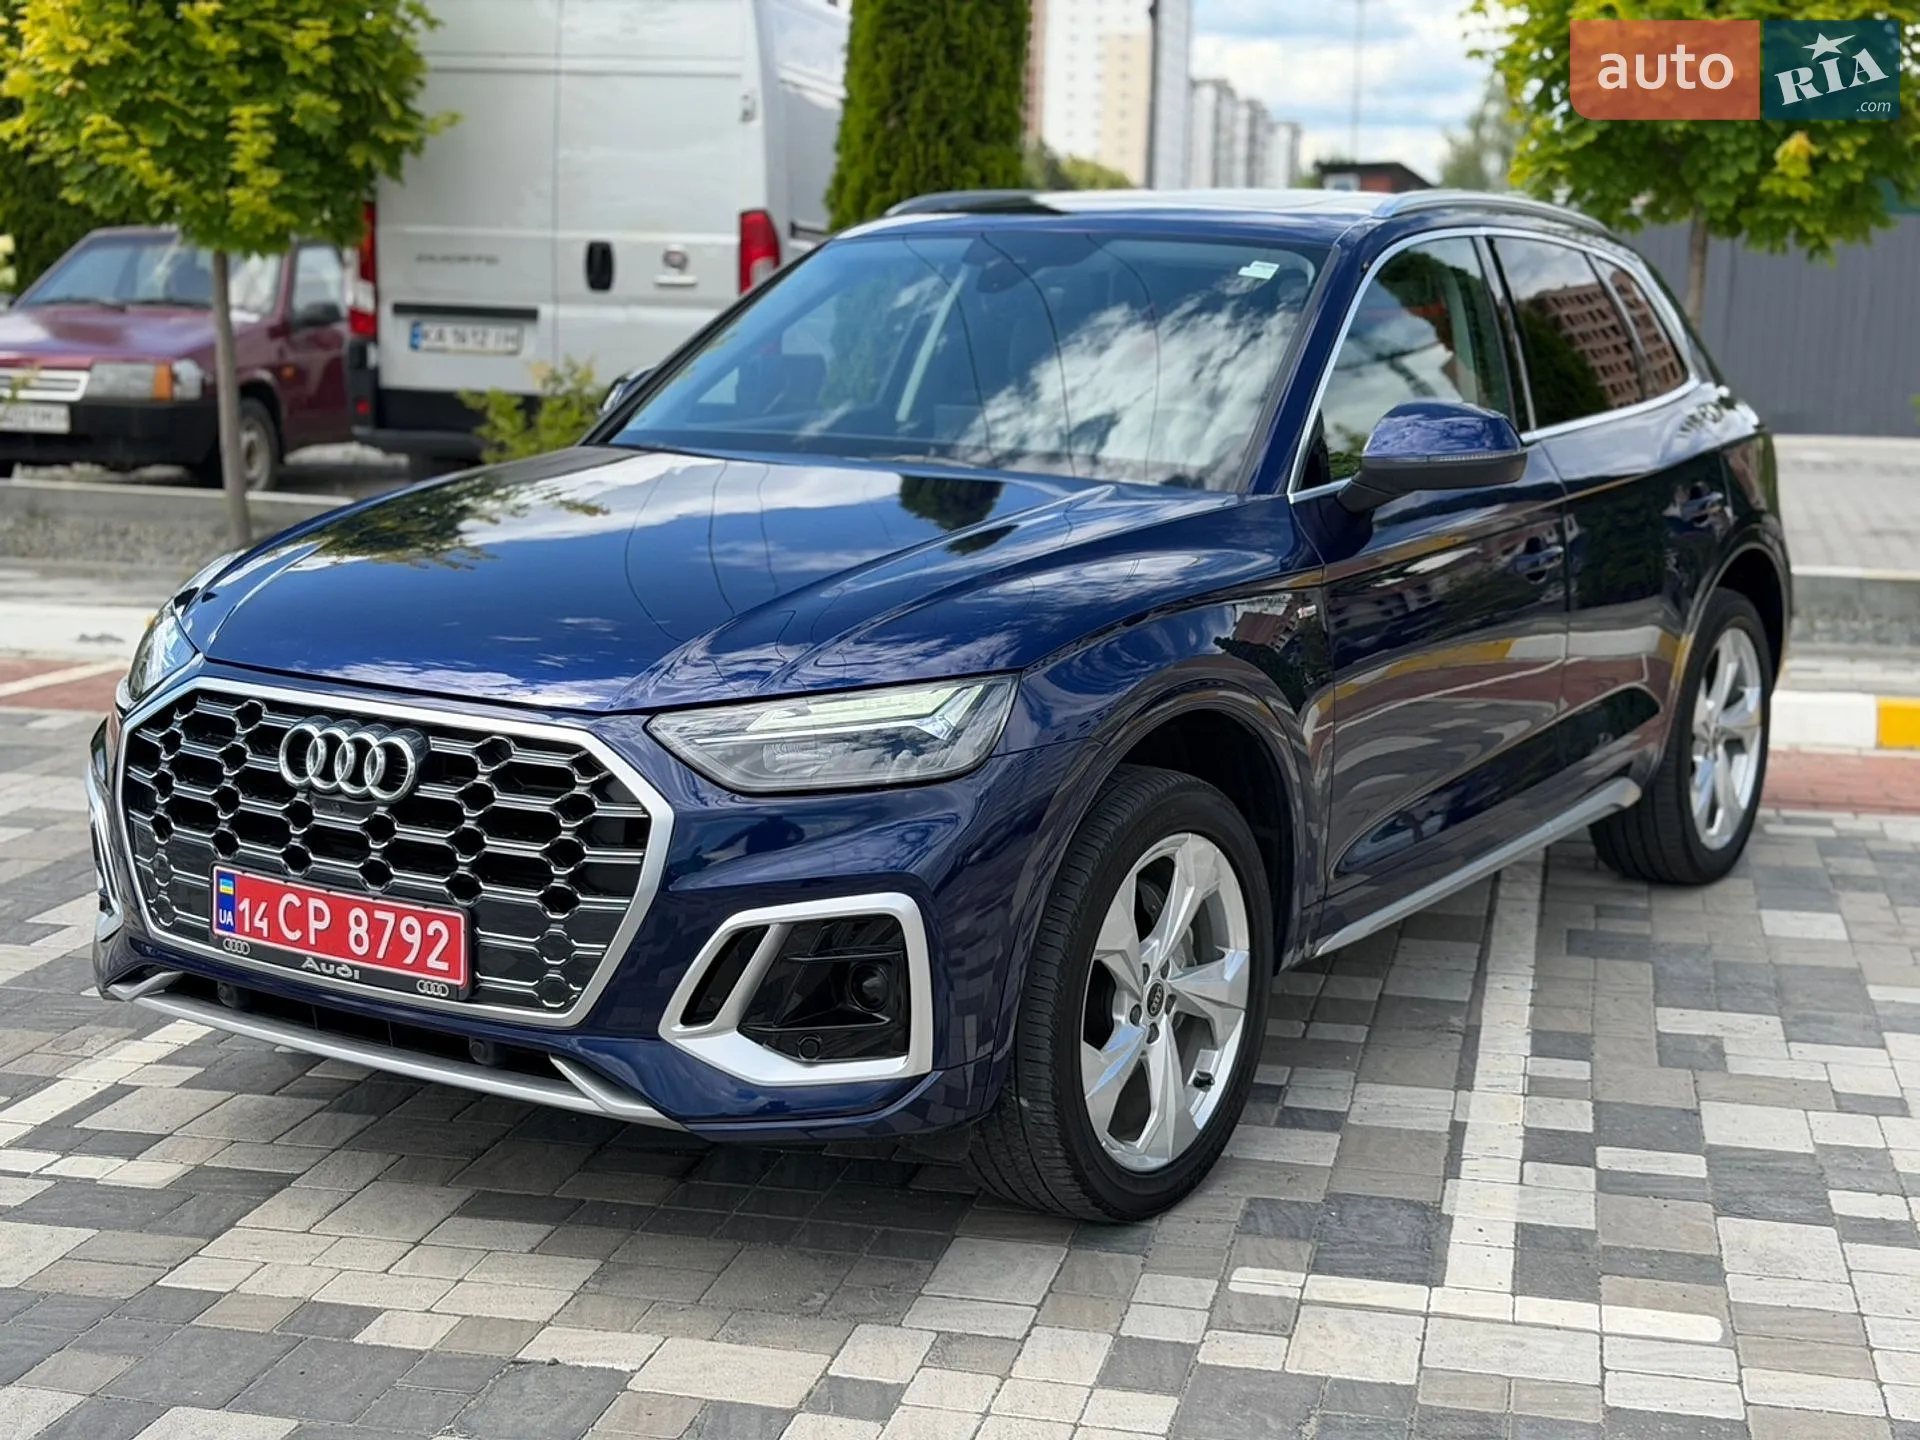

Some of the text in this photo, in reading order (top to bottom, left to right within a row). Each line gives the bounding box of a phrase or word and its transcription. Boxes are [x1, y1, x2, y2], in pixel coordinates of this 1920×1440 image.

[218, 908, 235, 928] UA
[238, 892, 451, 972] 14 CP 8792
[301, 957, 360, 981] Audi
